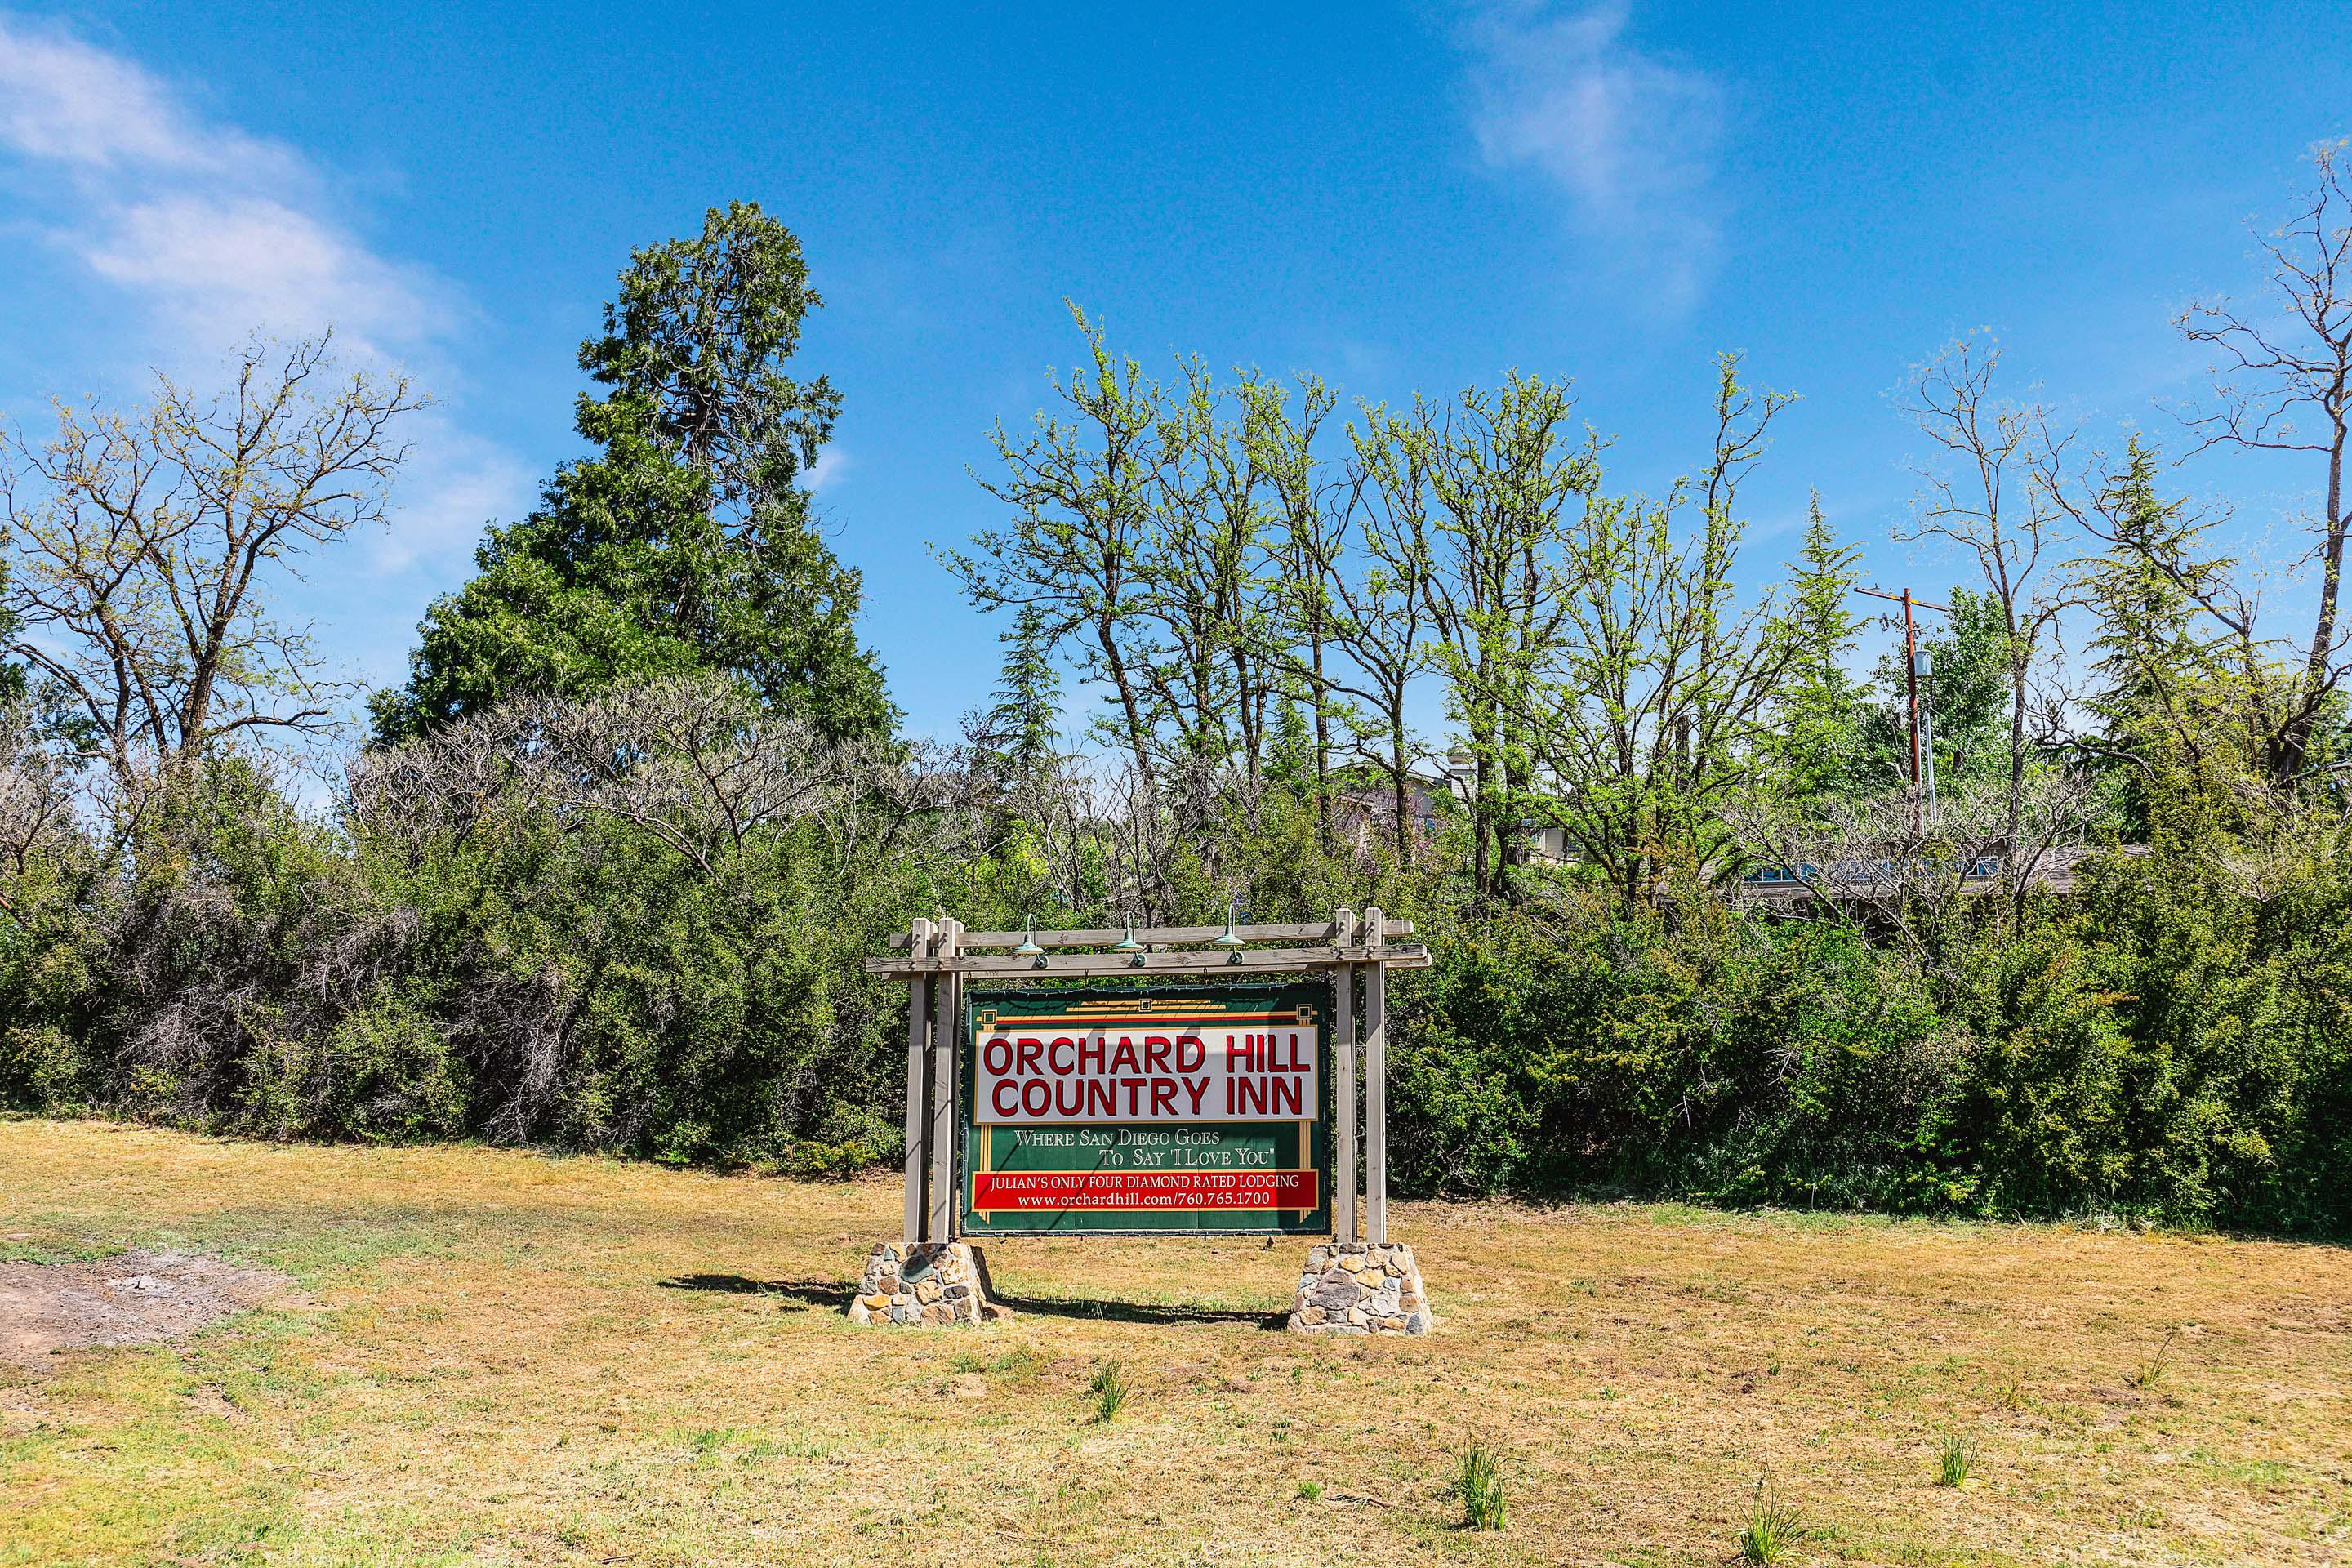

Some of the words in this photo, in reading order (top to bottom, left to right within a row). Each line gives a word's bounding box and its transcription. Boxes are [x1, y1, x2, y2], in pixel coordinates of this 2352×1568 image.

[983, 1036, 1206, 1076] ORCHARD
[1226, 1033, 1311, 1073] HILL
[991, 1076, 1211, 1117] COUNTRY
[1226, 1076, 1303, 1115] INN
[991, 1177, 1048, 1192] JULIAN'S
[1050, 1176, 1085, 1189] ONLY
[1089, 1176, 1123, 1188] FOUR
[1126, 1176, 1190, 1188] DIAMOND
[1193, 1175, 1236, 1188] RATED
[1239, 1174, 1299, 1187] LODGING
